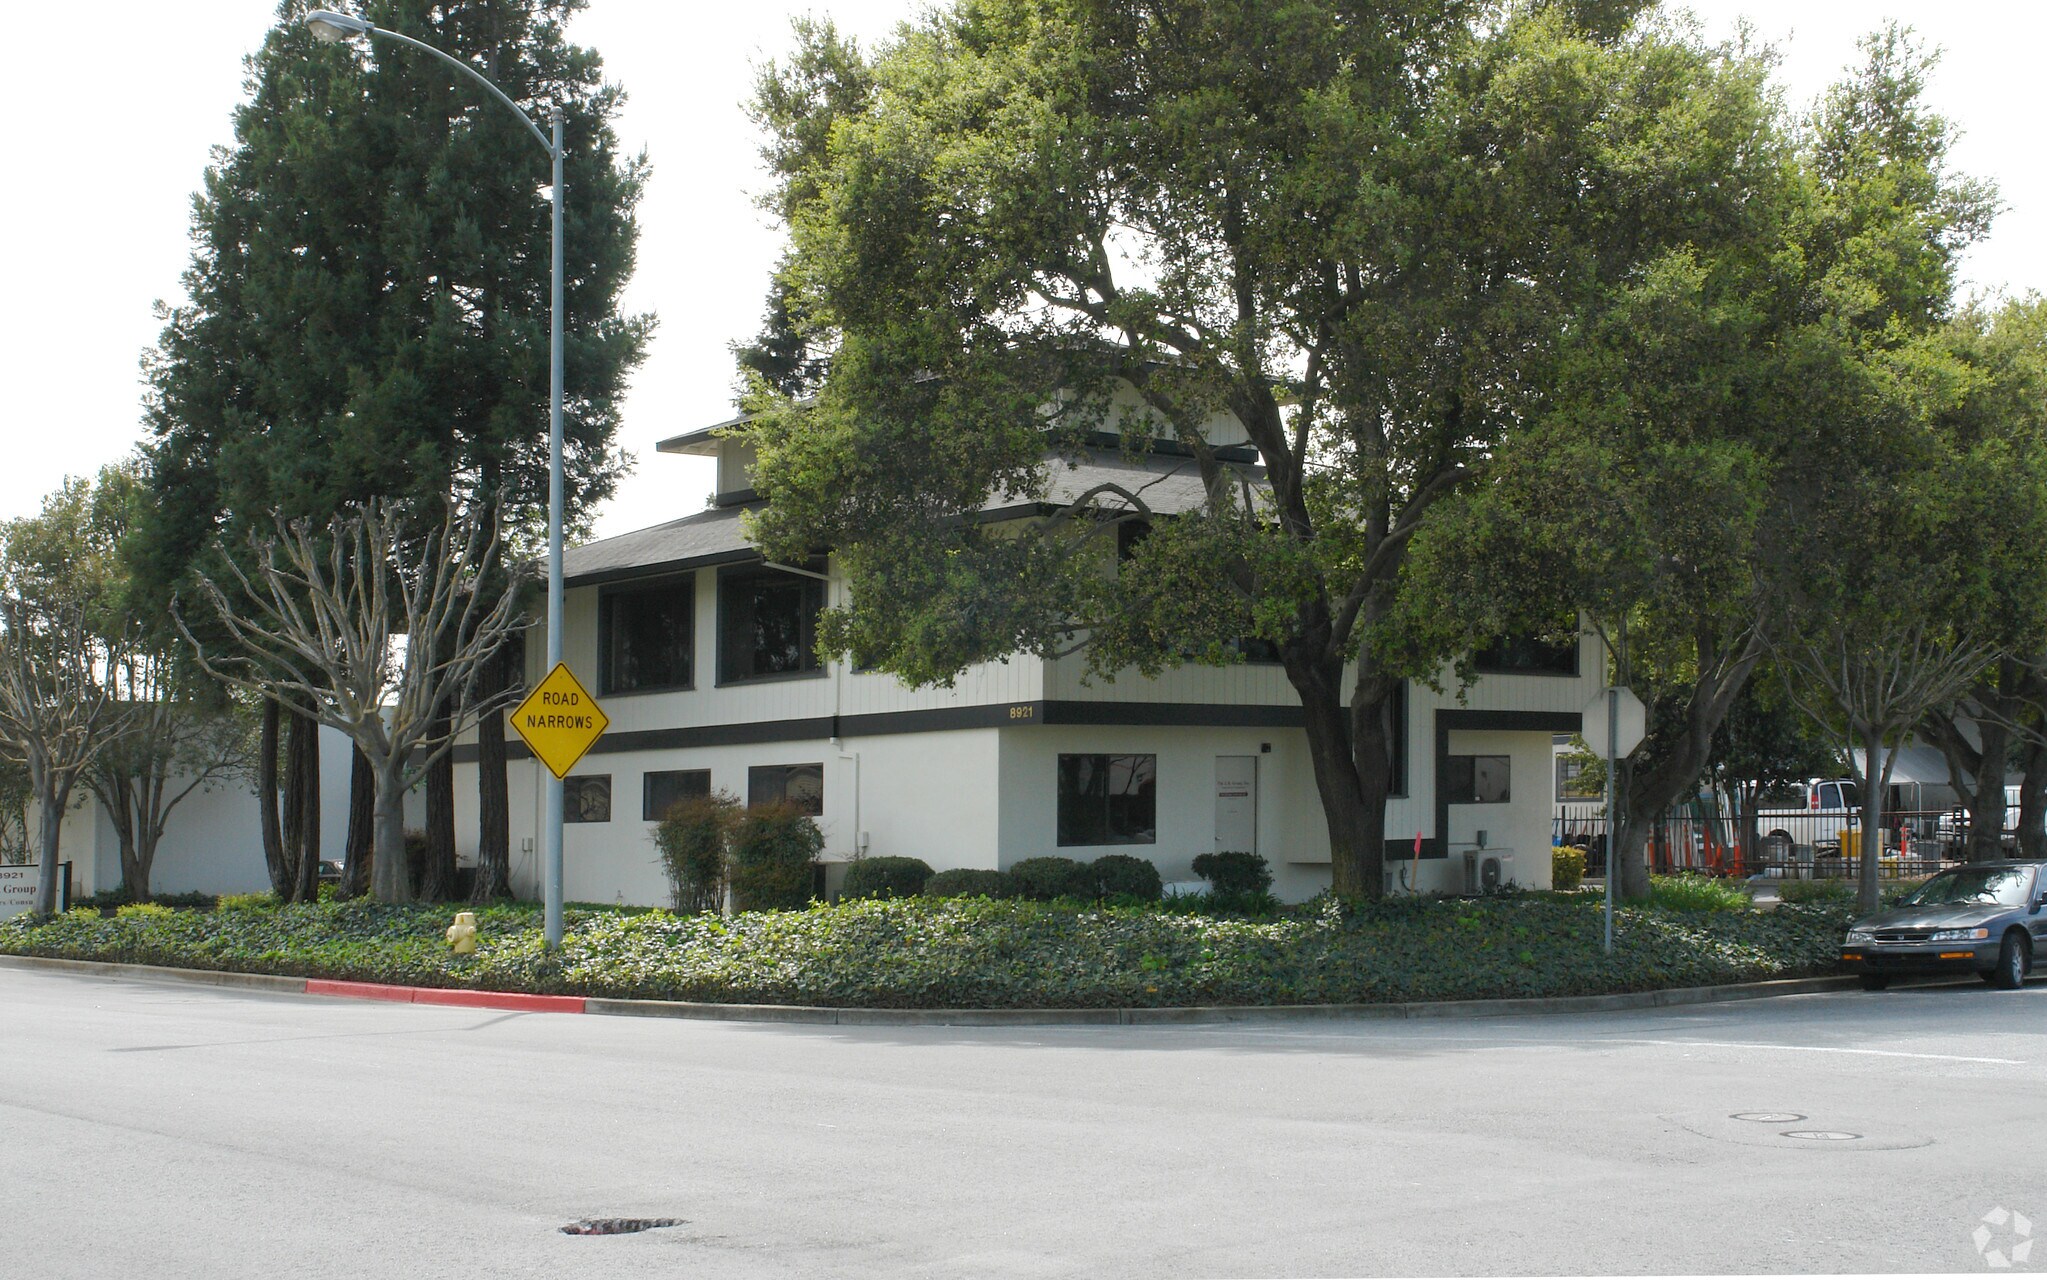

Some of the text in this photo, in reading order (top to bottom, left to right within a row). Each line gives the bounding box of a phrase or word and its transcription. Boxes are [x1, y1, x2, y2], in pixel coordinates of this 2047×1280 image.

[543, 692, 579, 706] ROAD
[1010, 706, 1033, 719] 8921
[527, 715, 593, 729] NARROWS
[3, 884, 37, 895] Group
